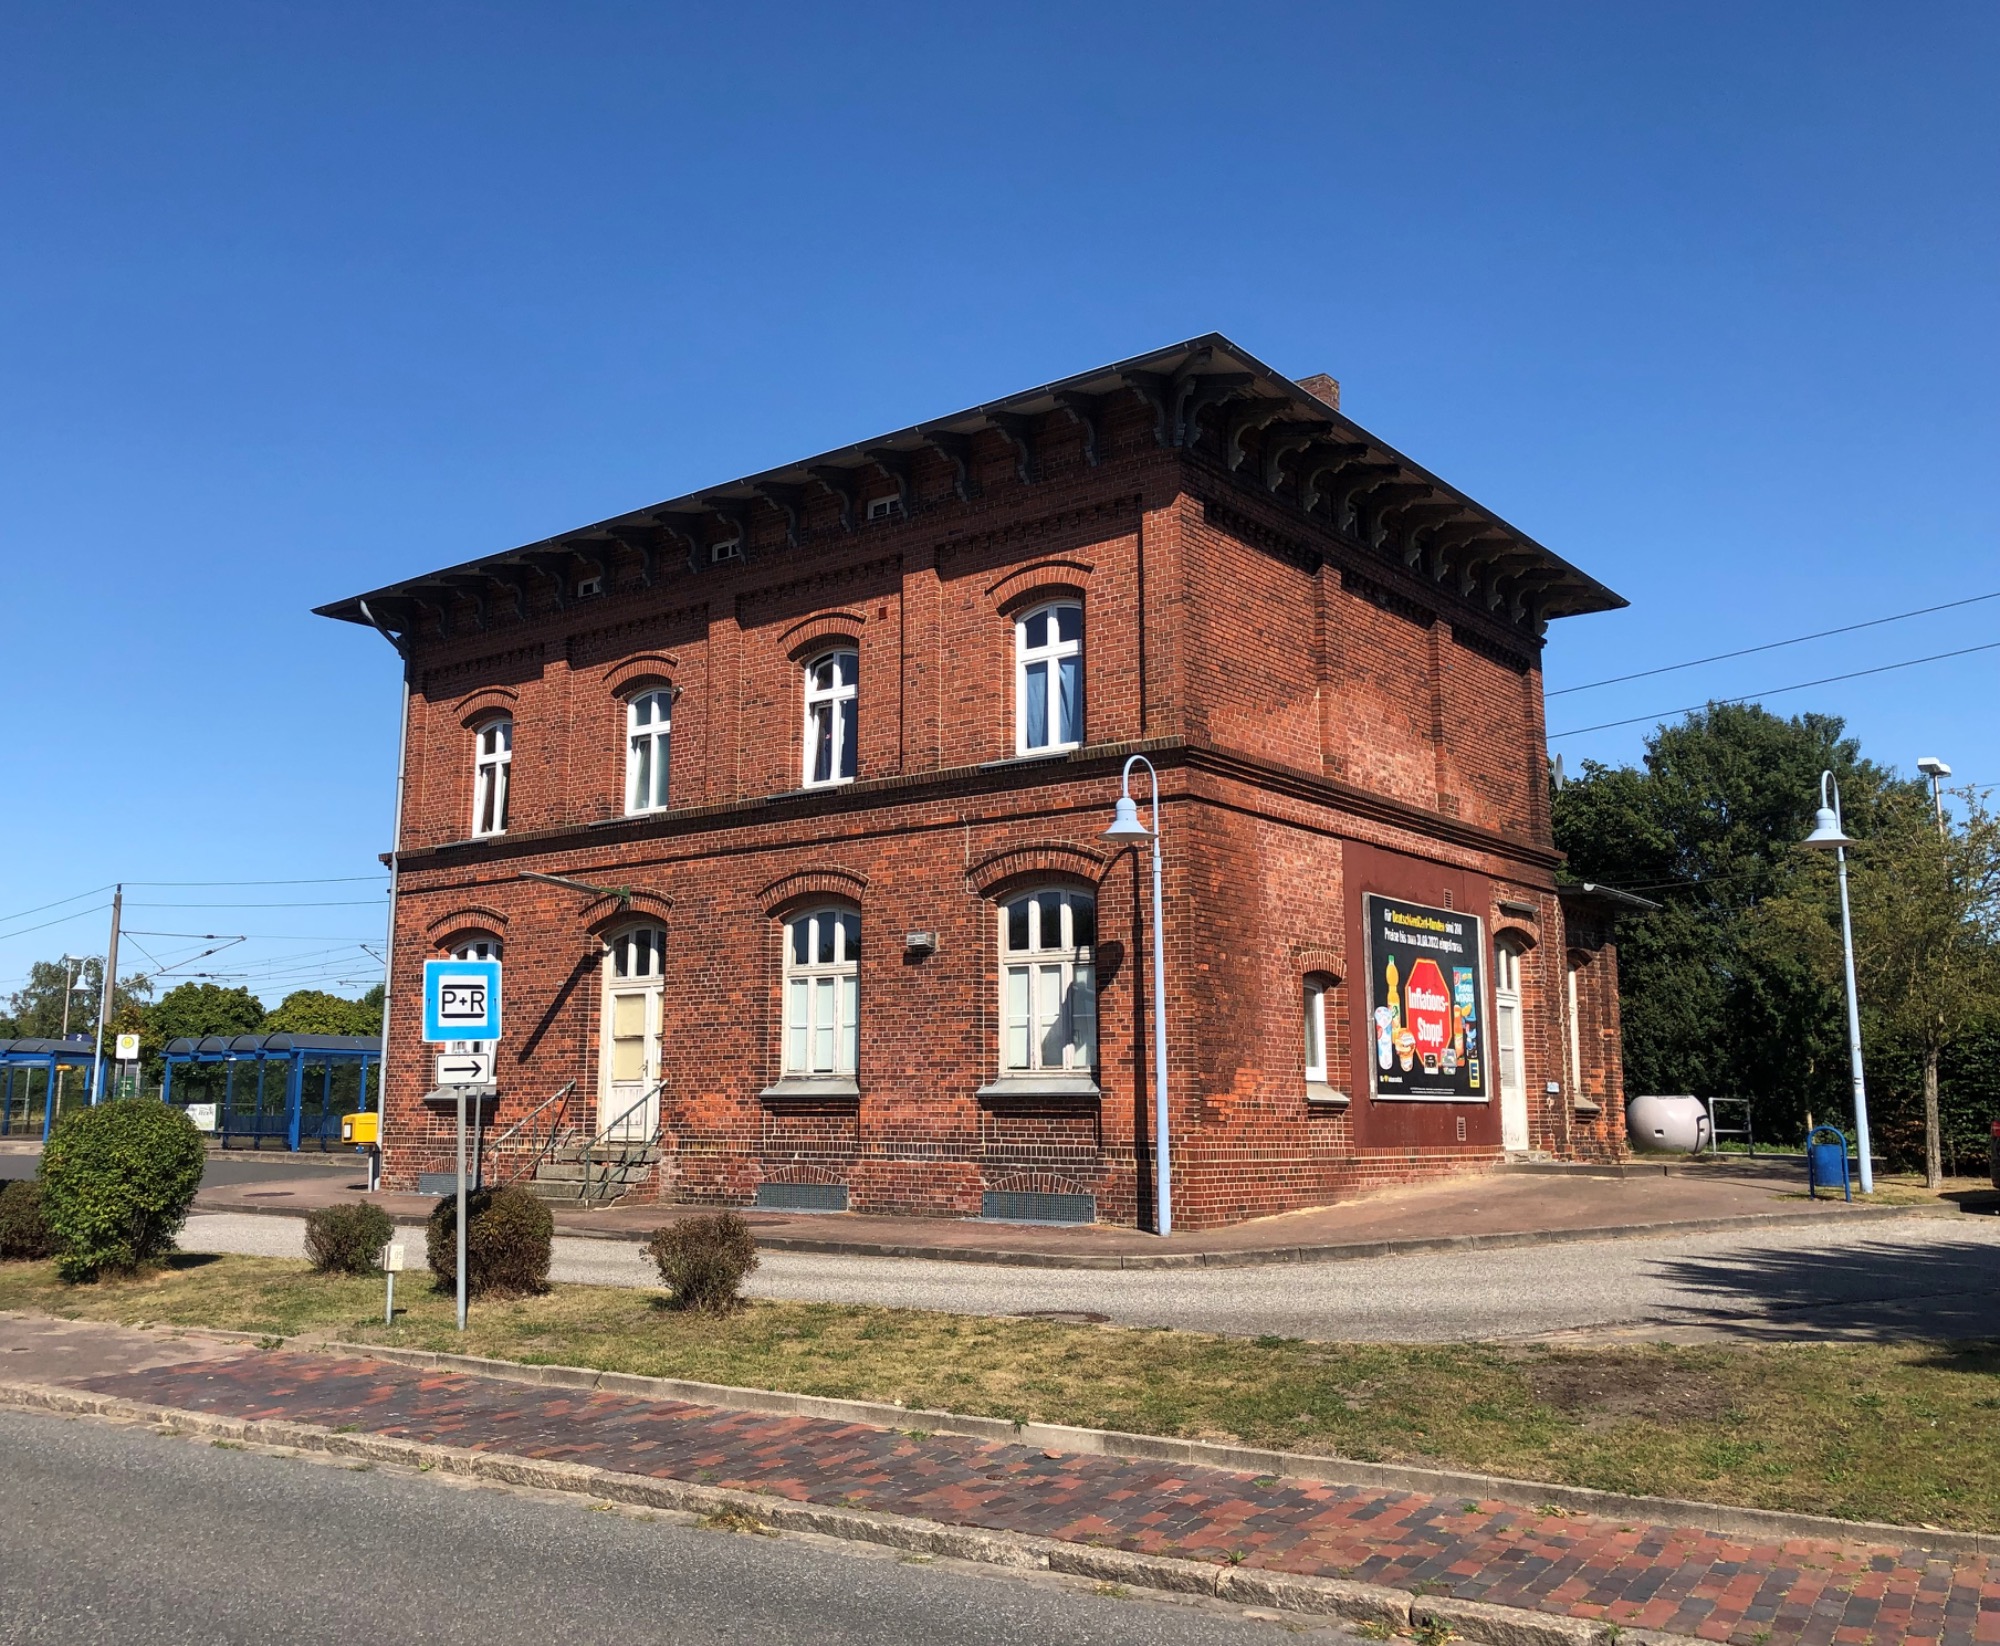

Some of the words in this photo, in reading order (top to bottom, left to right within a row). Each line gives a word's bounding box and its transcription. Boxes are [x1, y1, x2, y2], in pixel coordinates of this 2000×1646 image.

[1384, 927, 1399, 943] Preise
[1399, 930, 1407, 944] bis
[441, 990, 485, 1012] P+R
[1408, 986, 1449, 1013] Inflations-
[76, 1034, 82, 1042] 2
[1418, 1017, 1444, 1047] Stopp!
